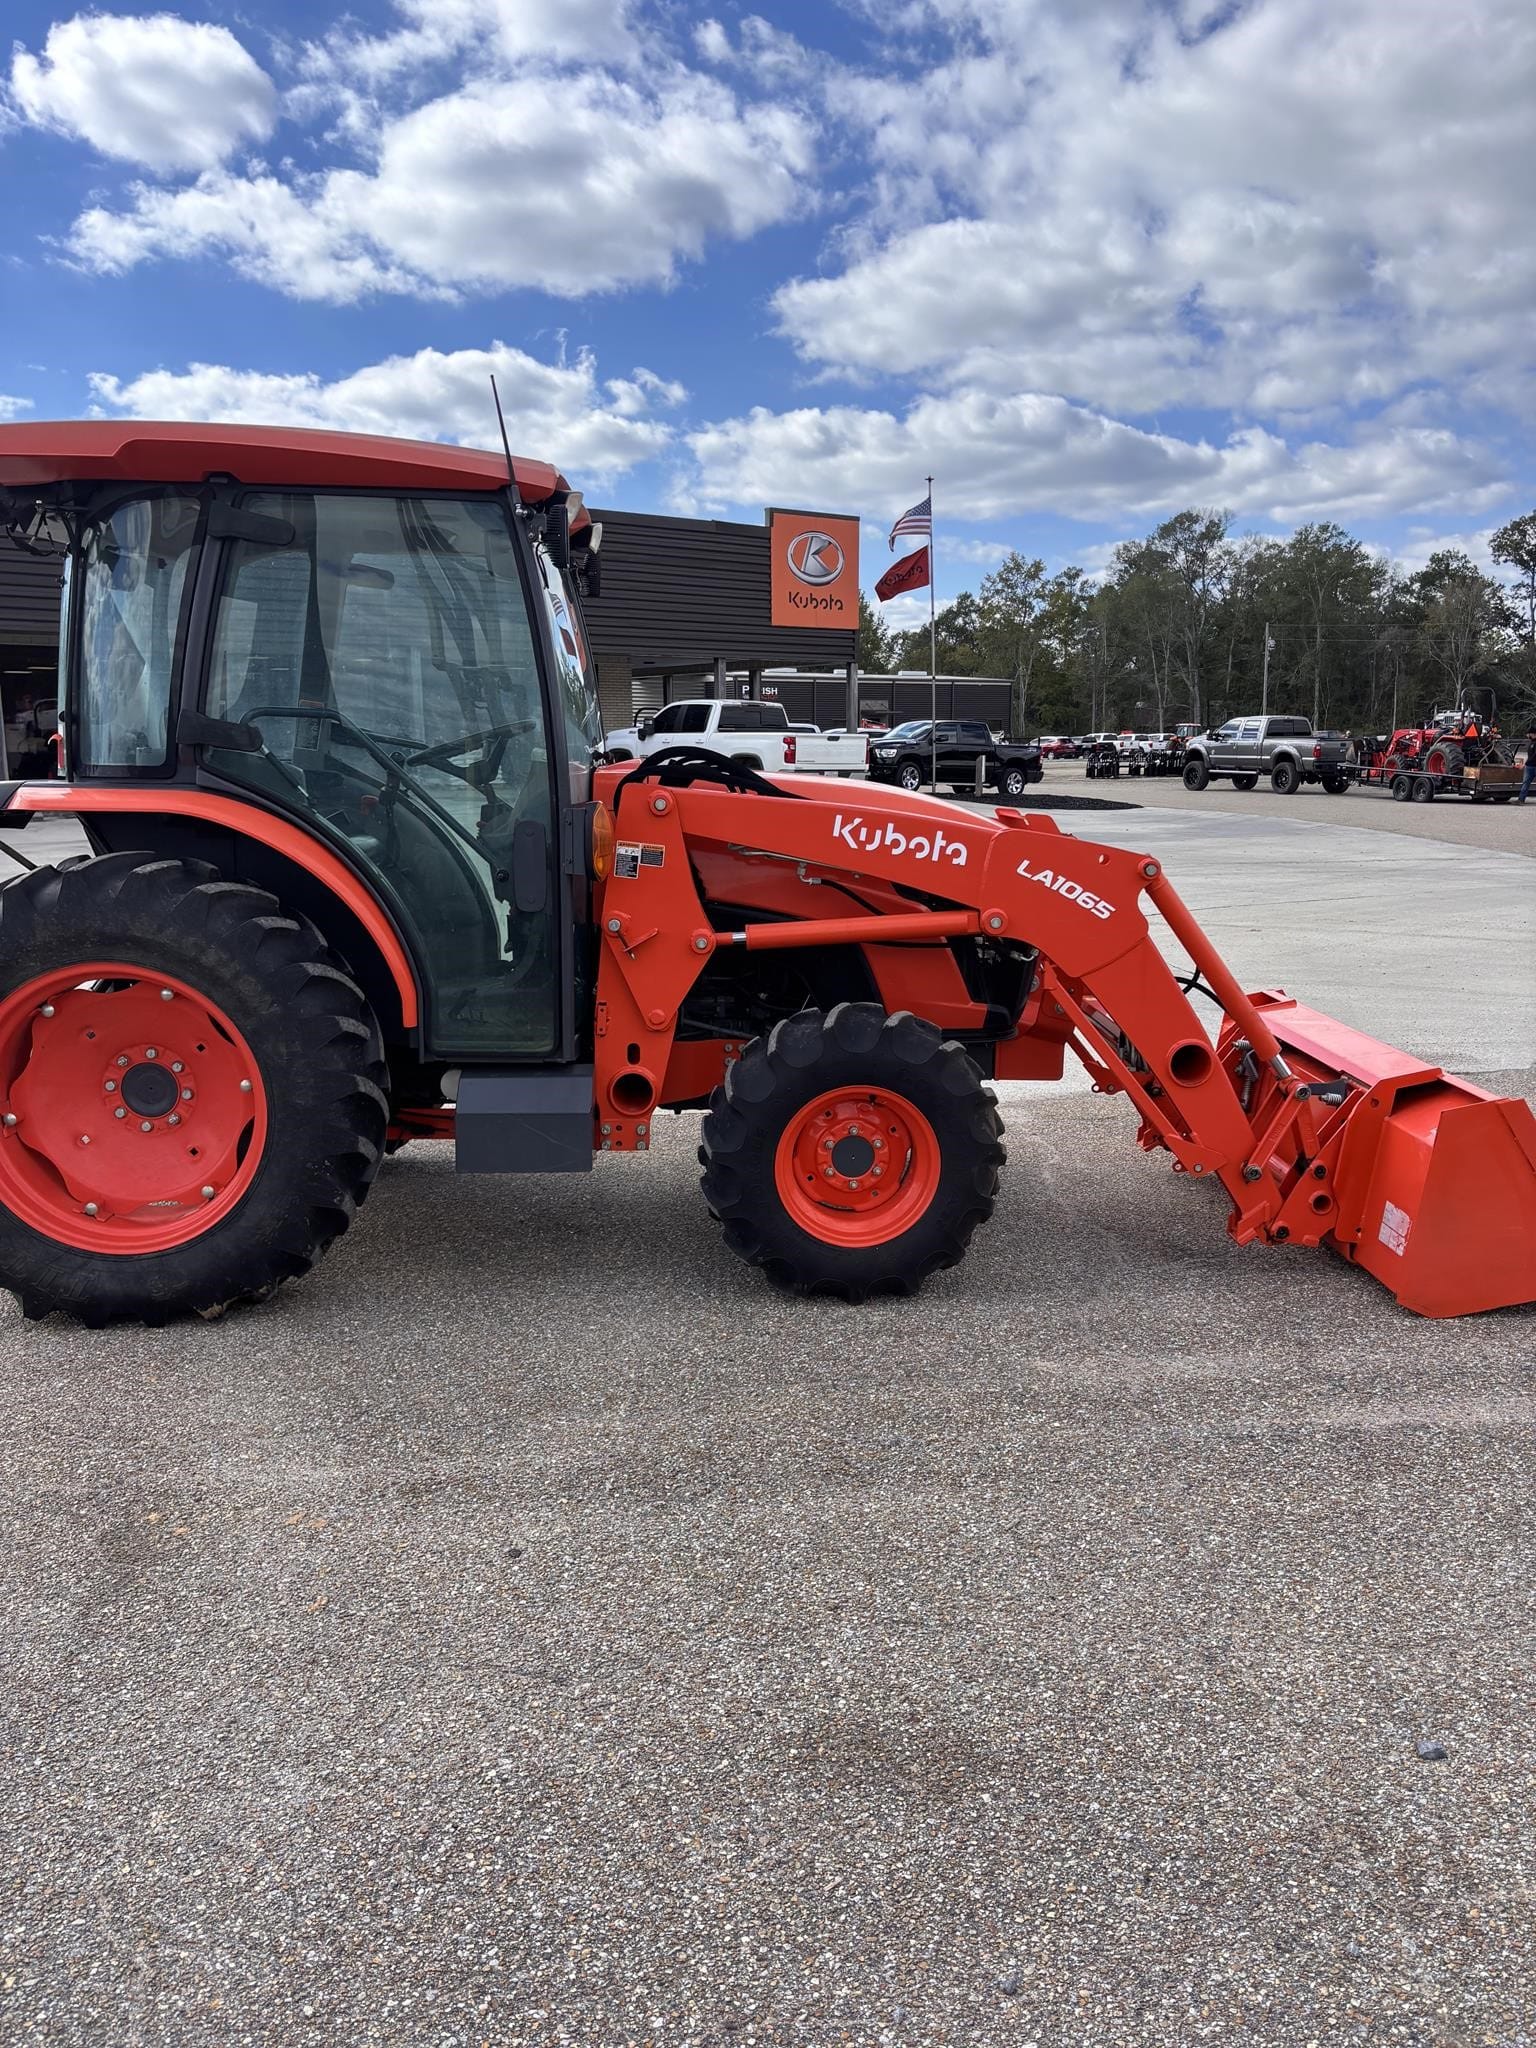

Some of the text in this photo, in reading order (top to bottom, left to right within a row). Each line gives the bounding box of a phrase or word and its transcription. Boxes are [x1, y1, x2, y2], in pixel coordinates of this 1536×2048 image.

[788, 591, 844, 611] Kubota
[742, 685, 778, 695] PISH
[832, 814, 968, 866] Kubota
[1016, 859, 1117, 920] LA1065
